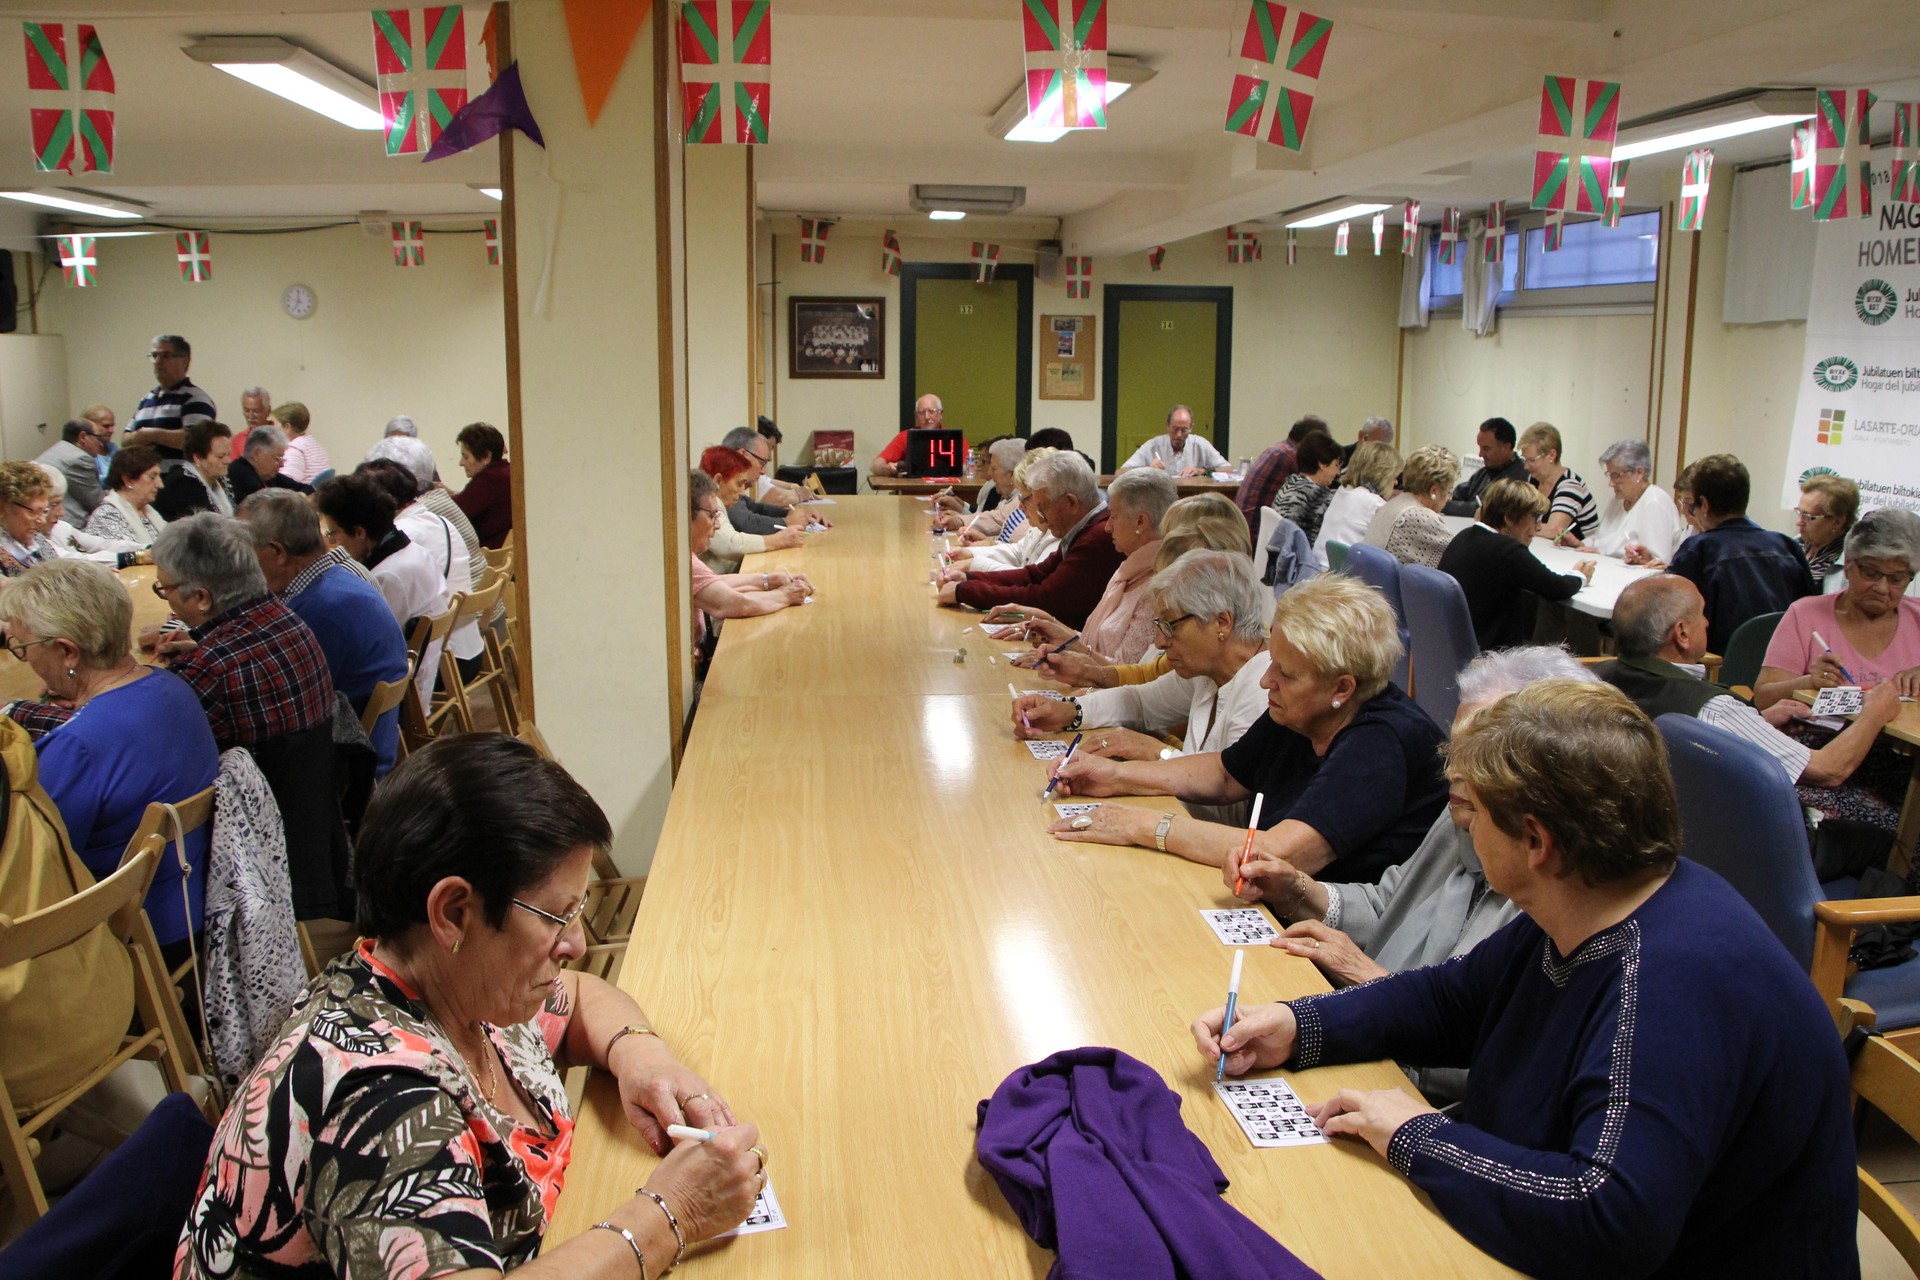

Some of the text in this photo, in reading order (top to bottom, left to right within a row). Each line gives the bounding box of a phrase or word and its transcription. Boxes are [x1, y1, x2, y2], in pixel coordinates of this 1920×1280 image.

[1870, 170, 1890, 186] 018
[1858, 237, 1920, 267] HOME
[1905, 288, 1920, 302] Ju
[1862, 365, 1903, 379] Jubilatuen
[1861, 379, 1883, 392] Hogar
[1885, 380, 1900, 391] del
[930, 439, 954, 467] 14
[1857, 479, 1891, 494] bilatuen
[1859, 495, 1872, 505] gar
[1873, 495, 1887, 506] del
